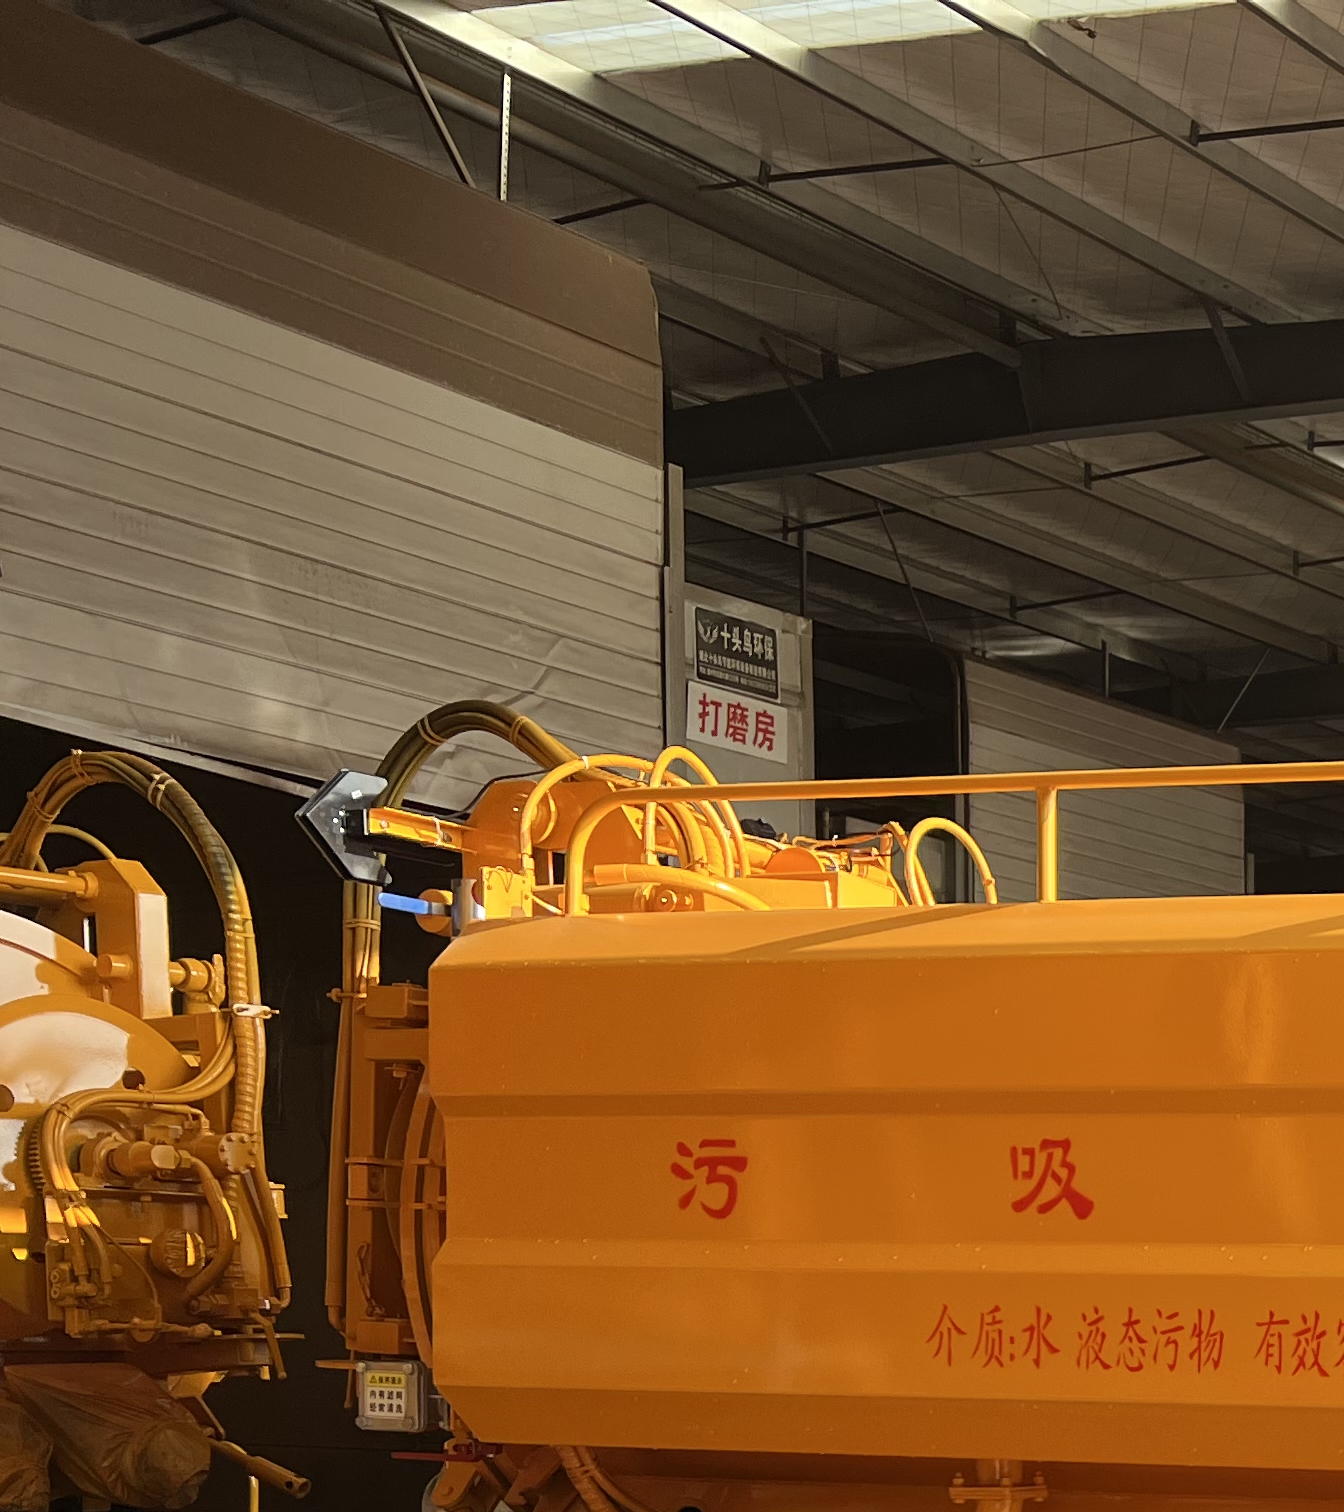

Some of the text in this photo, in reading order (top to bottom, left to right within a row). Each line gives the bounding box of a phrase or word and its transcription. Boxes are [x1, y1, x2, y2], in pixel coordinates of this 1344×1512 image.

[720, 622, 775, 662] 十头鸟环保
[698, 692, 776, 752] 打磨房
[670, 1138, 749, 1220] 污
[1010, 1138, 1095, 1220] 吸
[1077, 1306, 1224, 1373] 液态污物
